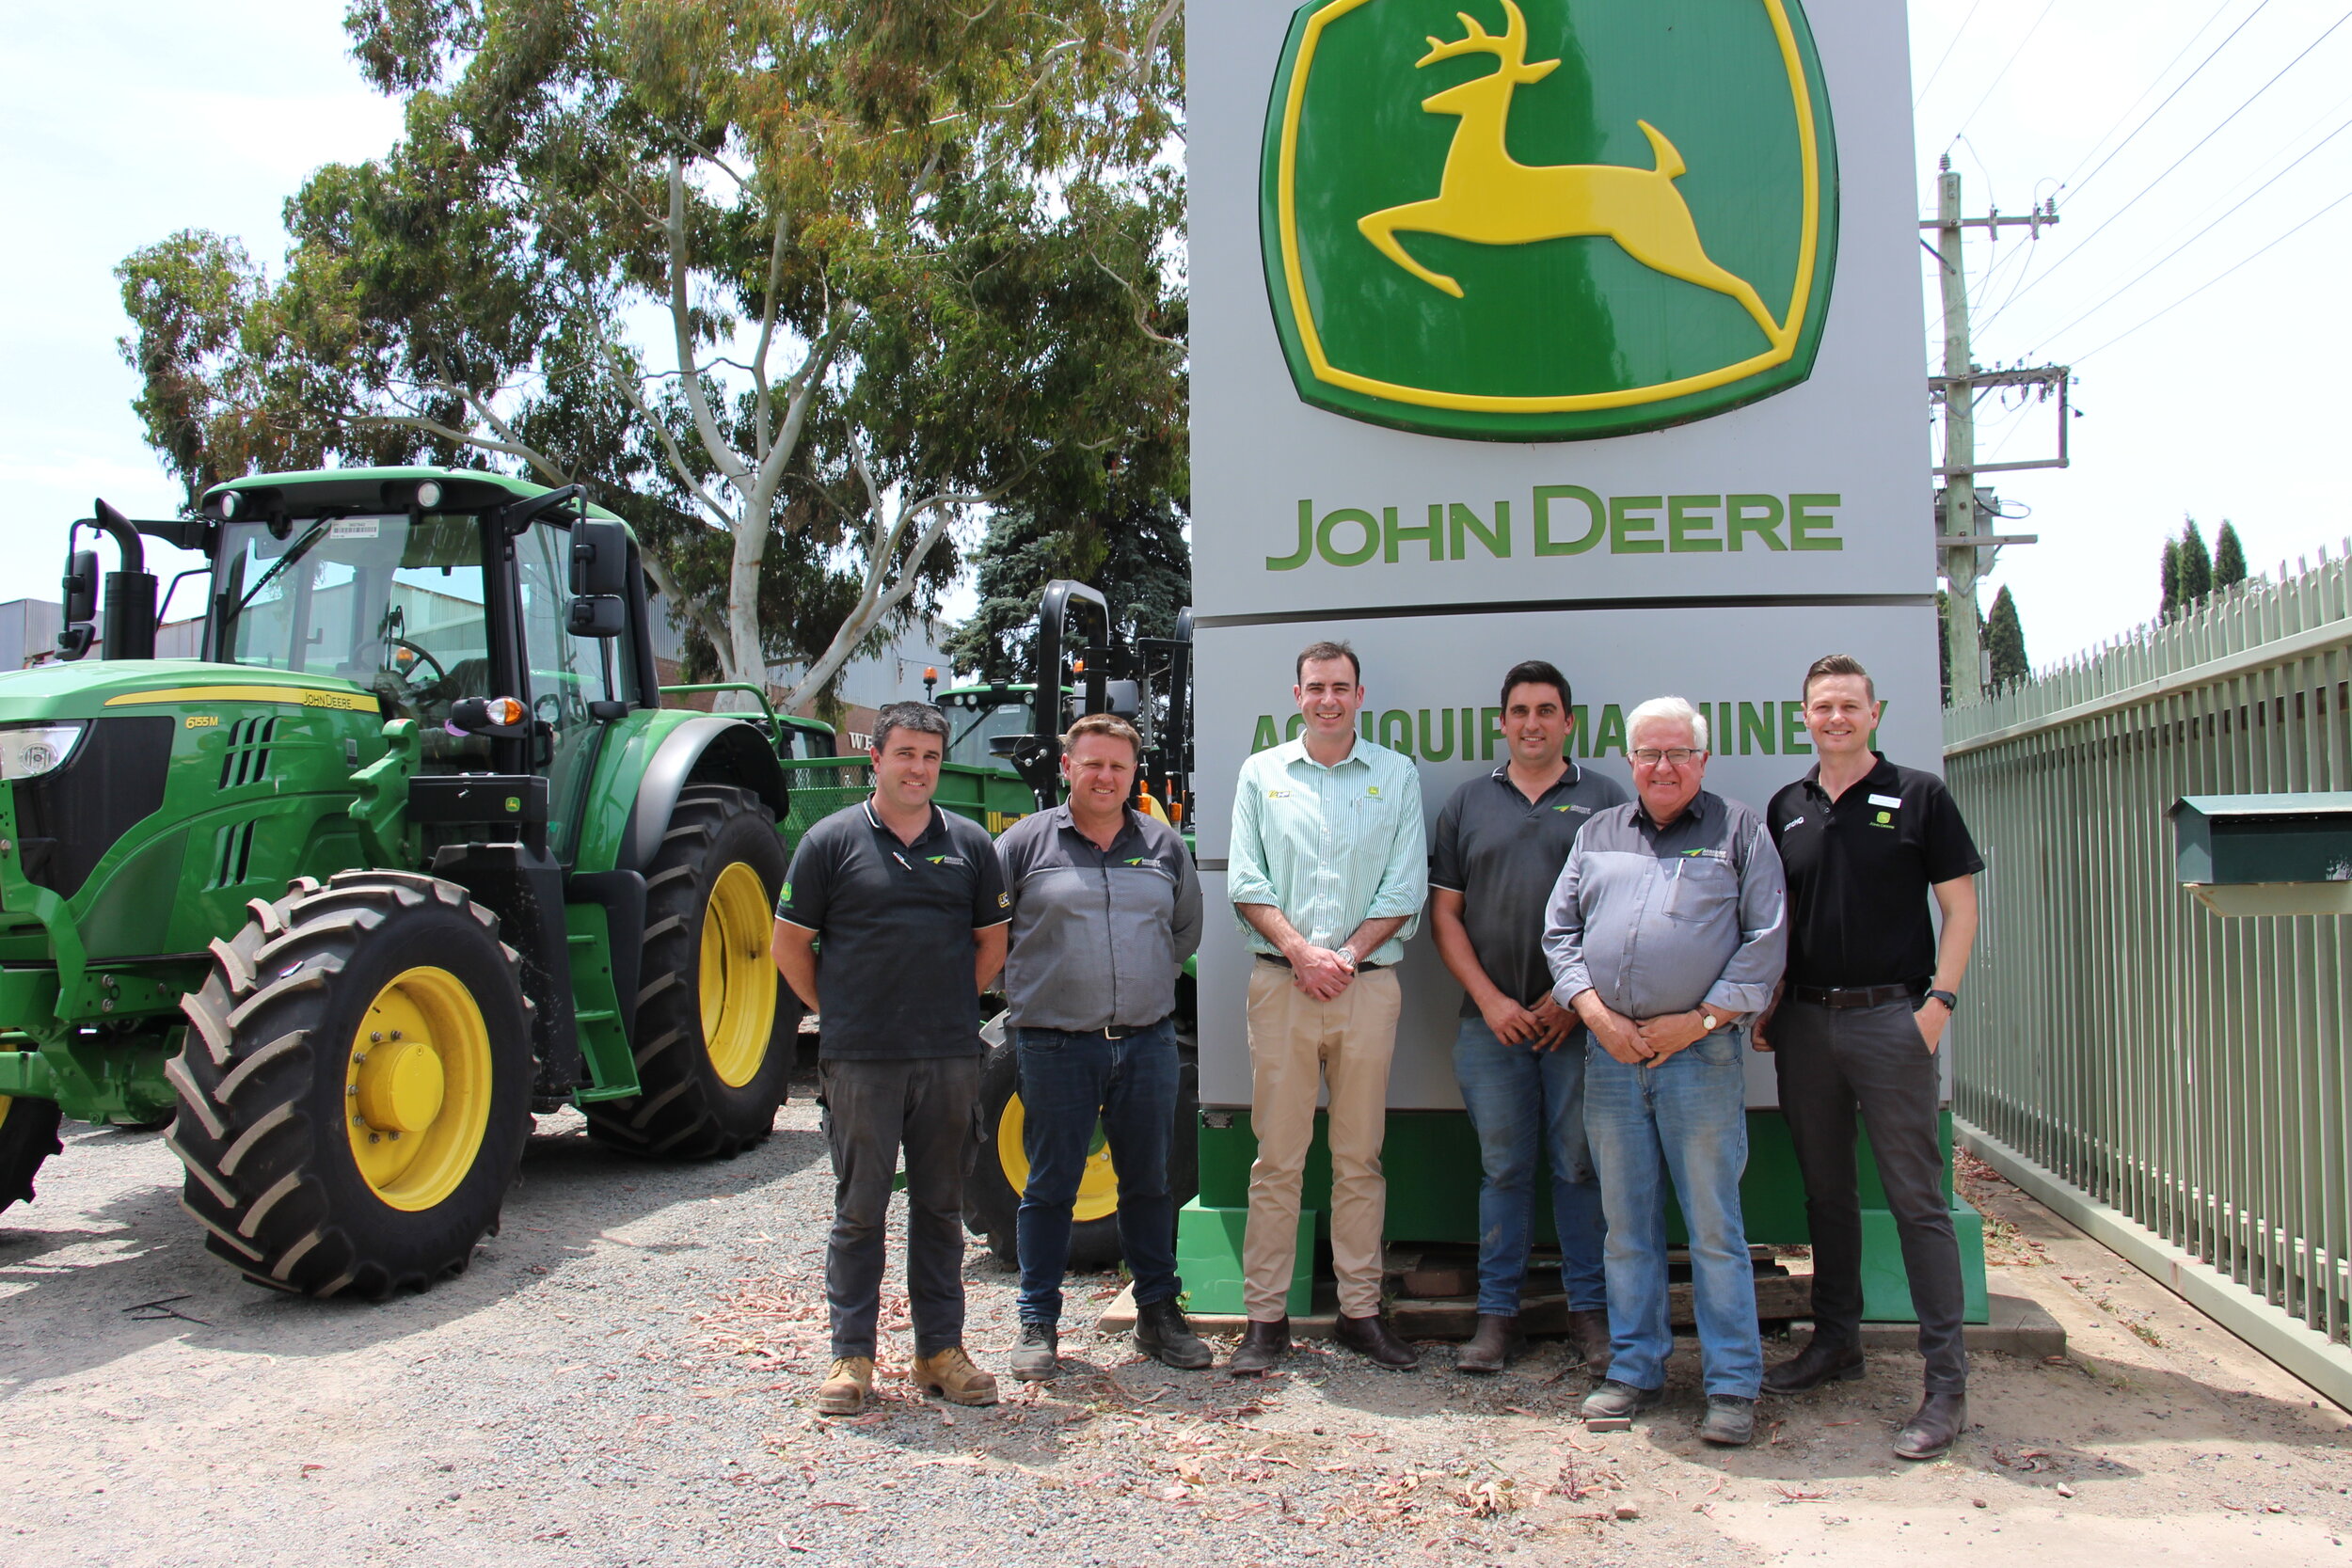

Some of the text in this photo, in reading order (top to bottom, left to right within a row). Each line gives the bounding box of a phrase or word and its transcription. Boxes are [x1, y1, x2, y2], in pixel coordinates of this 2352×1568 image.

[1265, 484, 1844, 571] JOHN DEERE
[303, 691, 352, 708] JOHN DEERE
[186, 716, 218, 729] 6155M
[1250, 706, 1504, 763] AIQUIP
